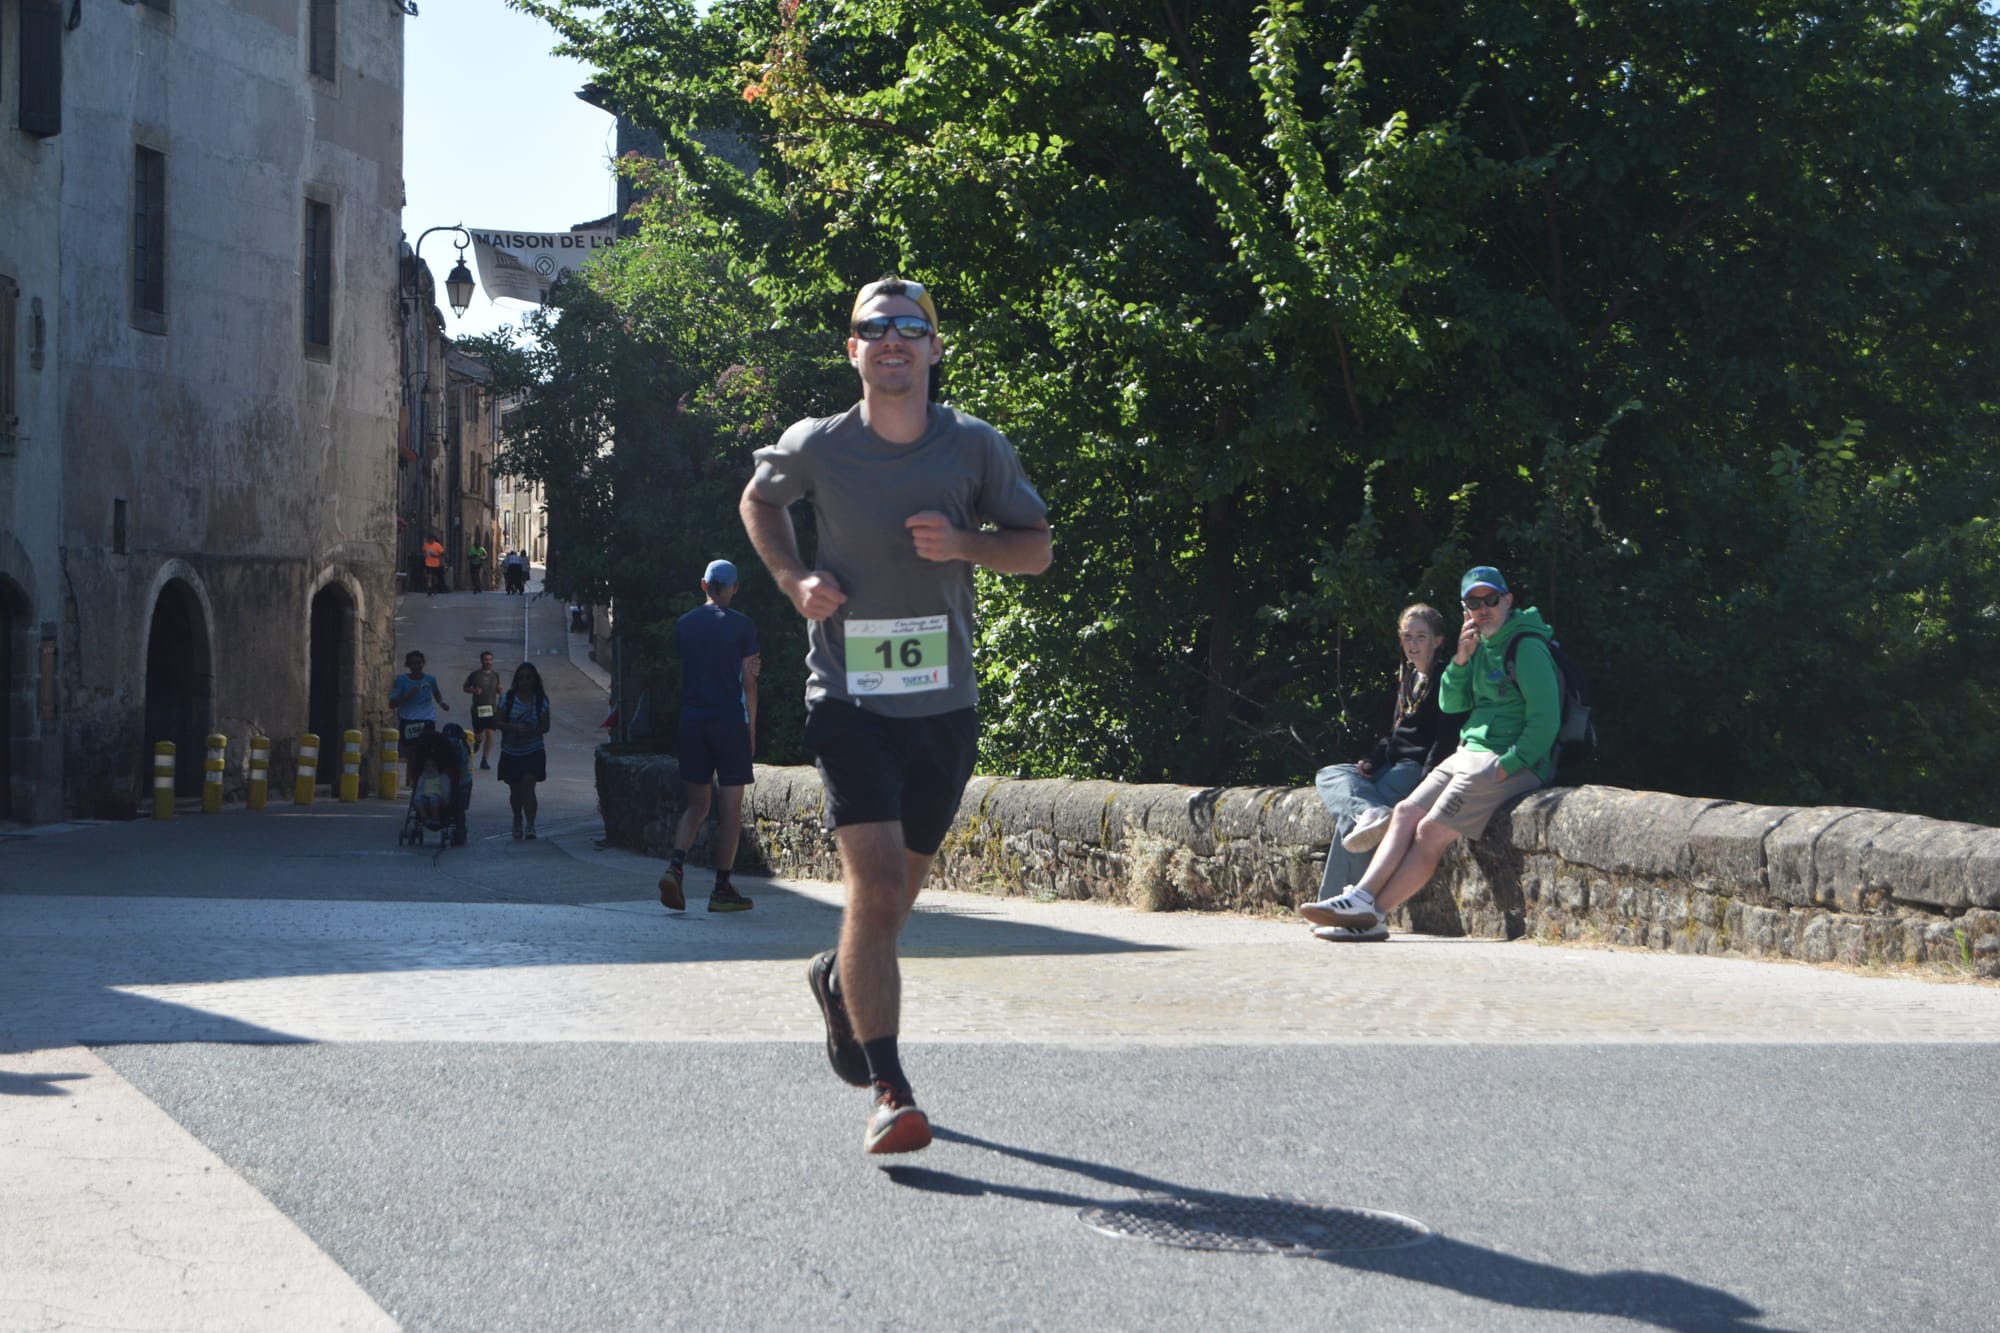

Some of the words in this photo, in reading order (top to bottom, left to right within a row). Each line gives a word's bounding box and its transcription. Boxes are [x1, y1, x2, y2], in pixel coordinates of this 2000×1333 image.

[475, 233, 553, 249] MAISON
[561, 235, 585, 249] DE
[875, 638, 922, 669] 16
